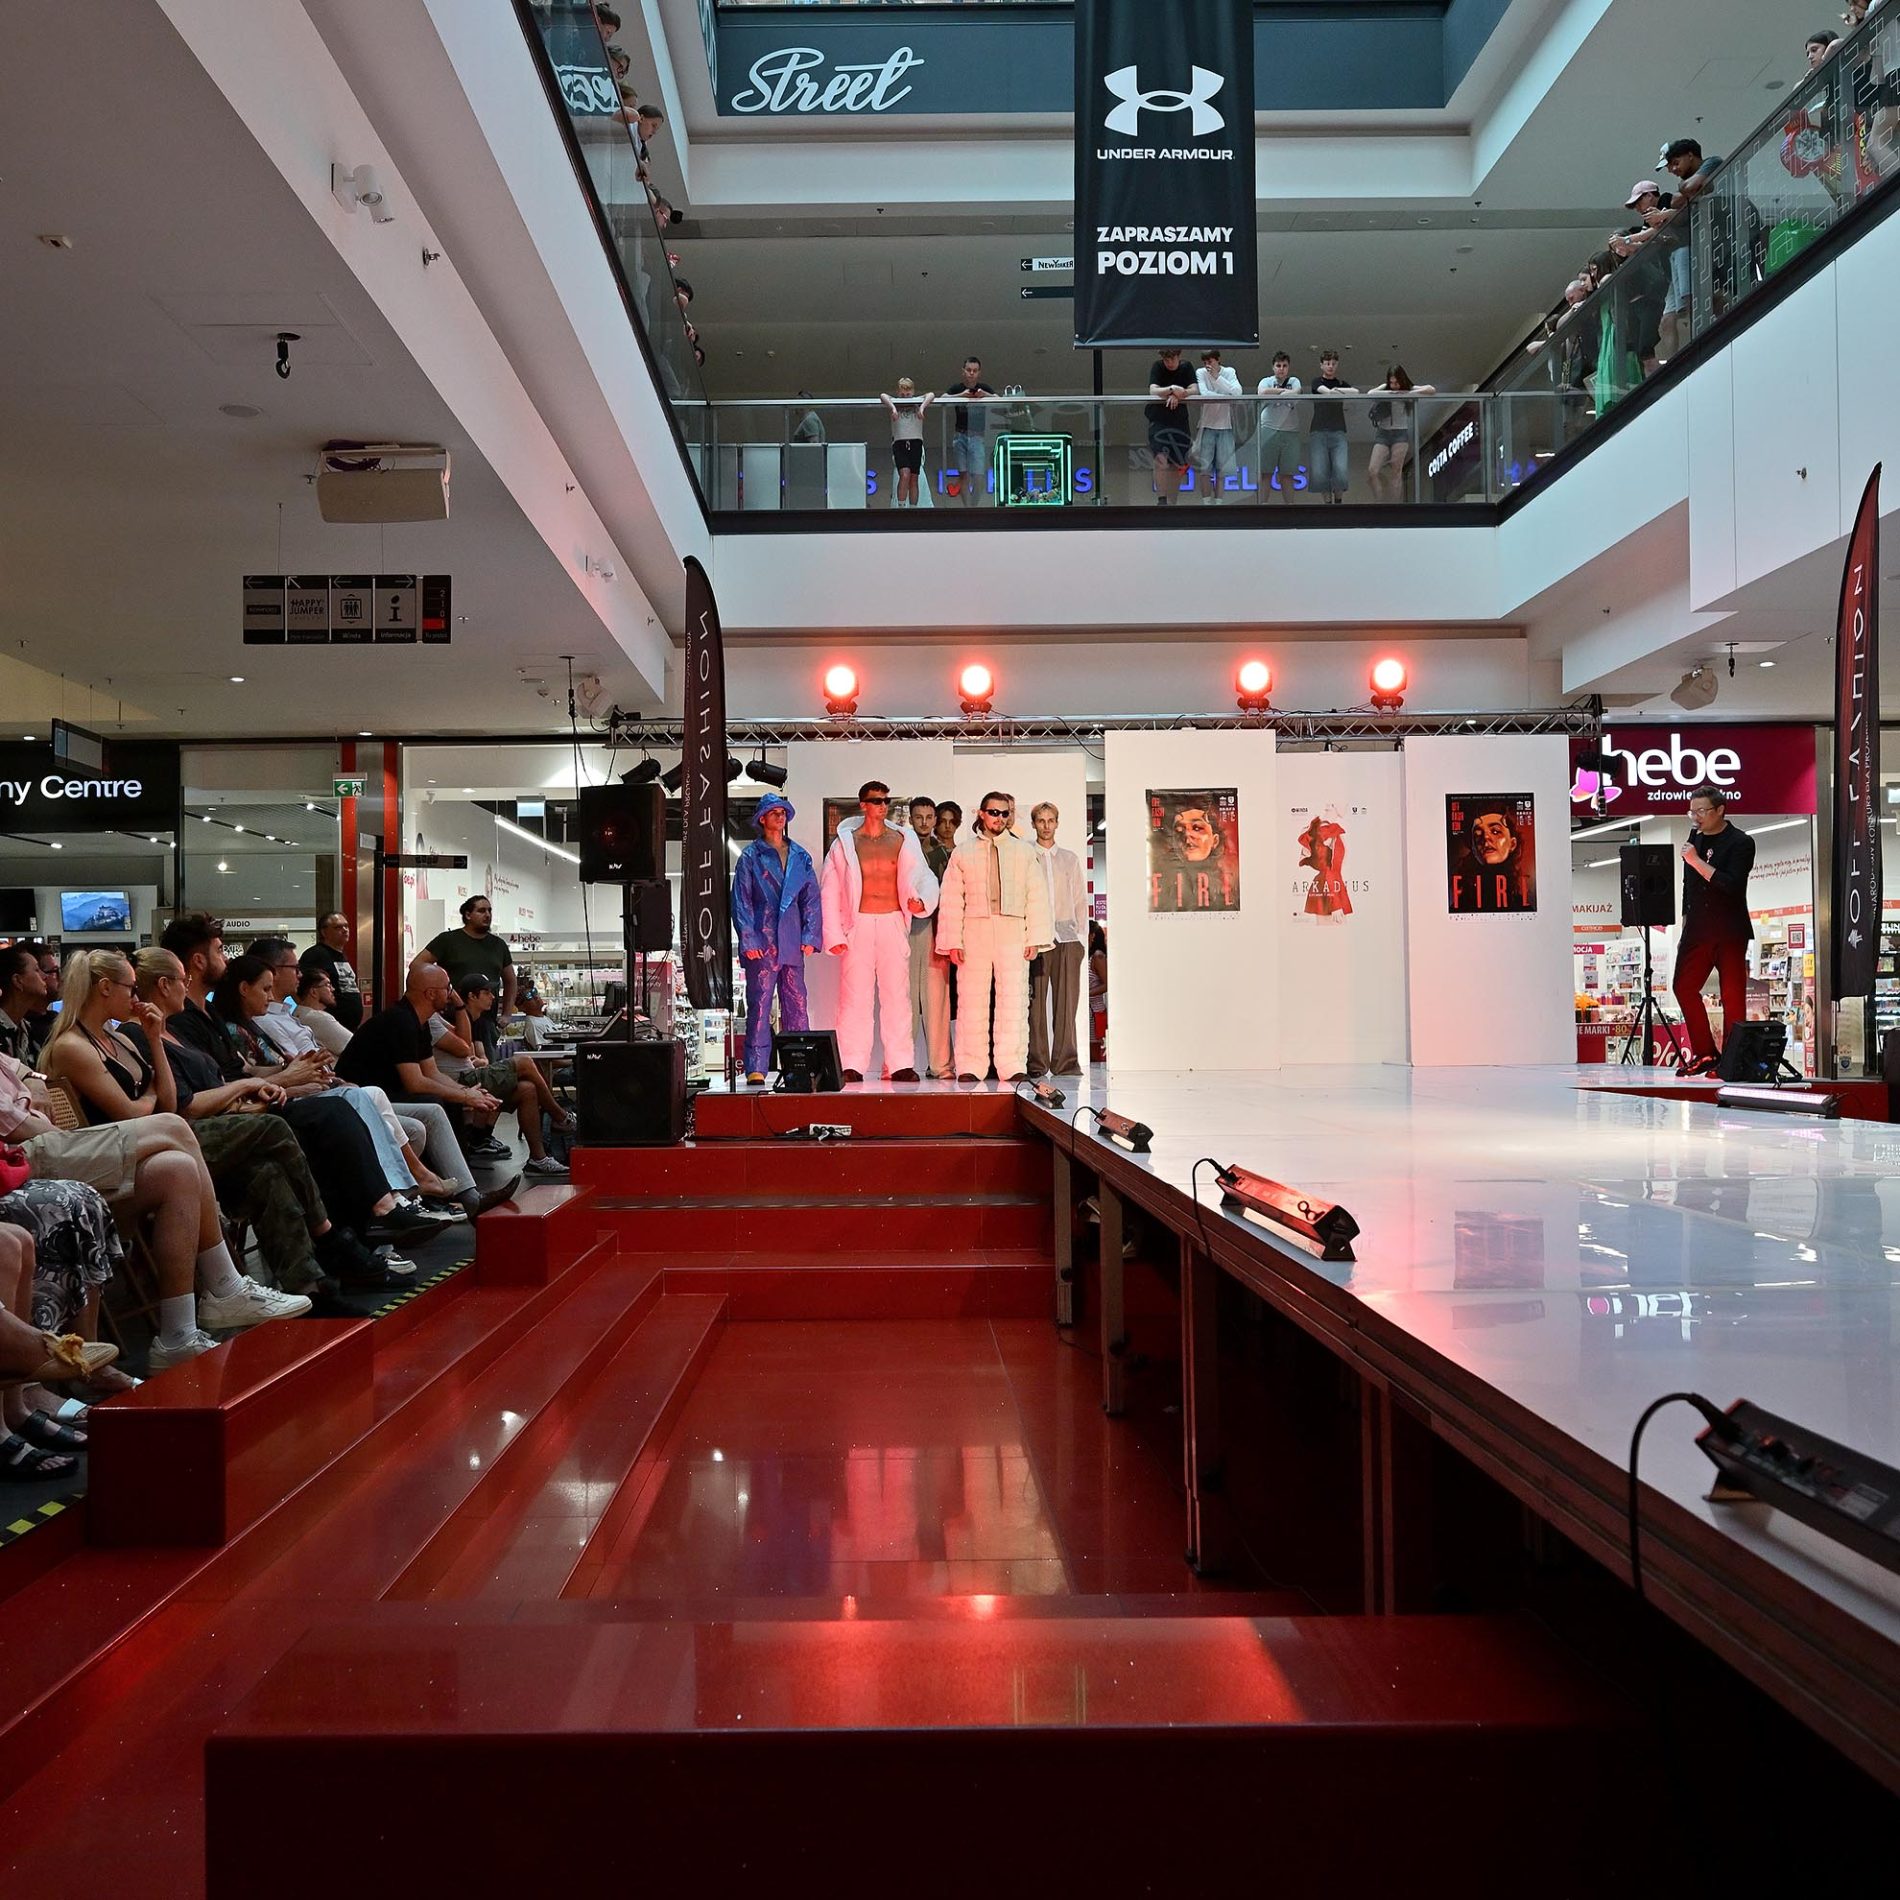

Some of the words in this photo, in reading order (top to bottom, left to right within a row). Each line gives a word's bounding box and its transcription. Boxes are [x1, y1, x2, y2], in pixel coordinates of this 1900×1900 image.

[731, 46, 925, 113] Street
[1097, 149, 1155, 160] UNDER
[1158, 149, 1234, 161] ARMOUR
[1097, 227, 1234, 243] ZAPRASZAMY
[1097, 250, 1220, 275] POZIOM
[1222, 251, 1234, 275] 1
[1428, 448, 1448, 478] COSTA
[1448, 421, 1474, 459] COFFEE
[289, 606, 324, 615] JUMPER
[1602, 733, 1742, 787] hebe
[40, 775, 142, 799] Centre
[1151, 872, 1235, 908] FIRE
[1292, 880, 1370, 893] ARKADUS
[1452, 874, 1531, 909] FIRE
[226, 920, 251, 928] AUDIO
[517, 933, 541, 943] hebe
[1584, 1025, 1610, 1035] MARKI
